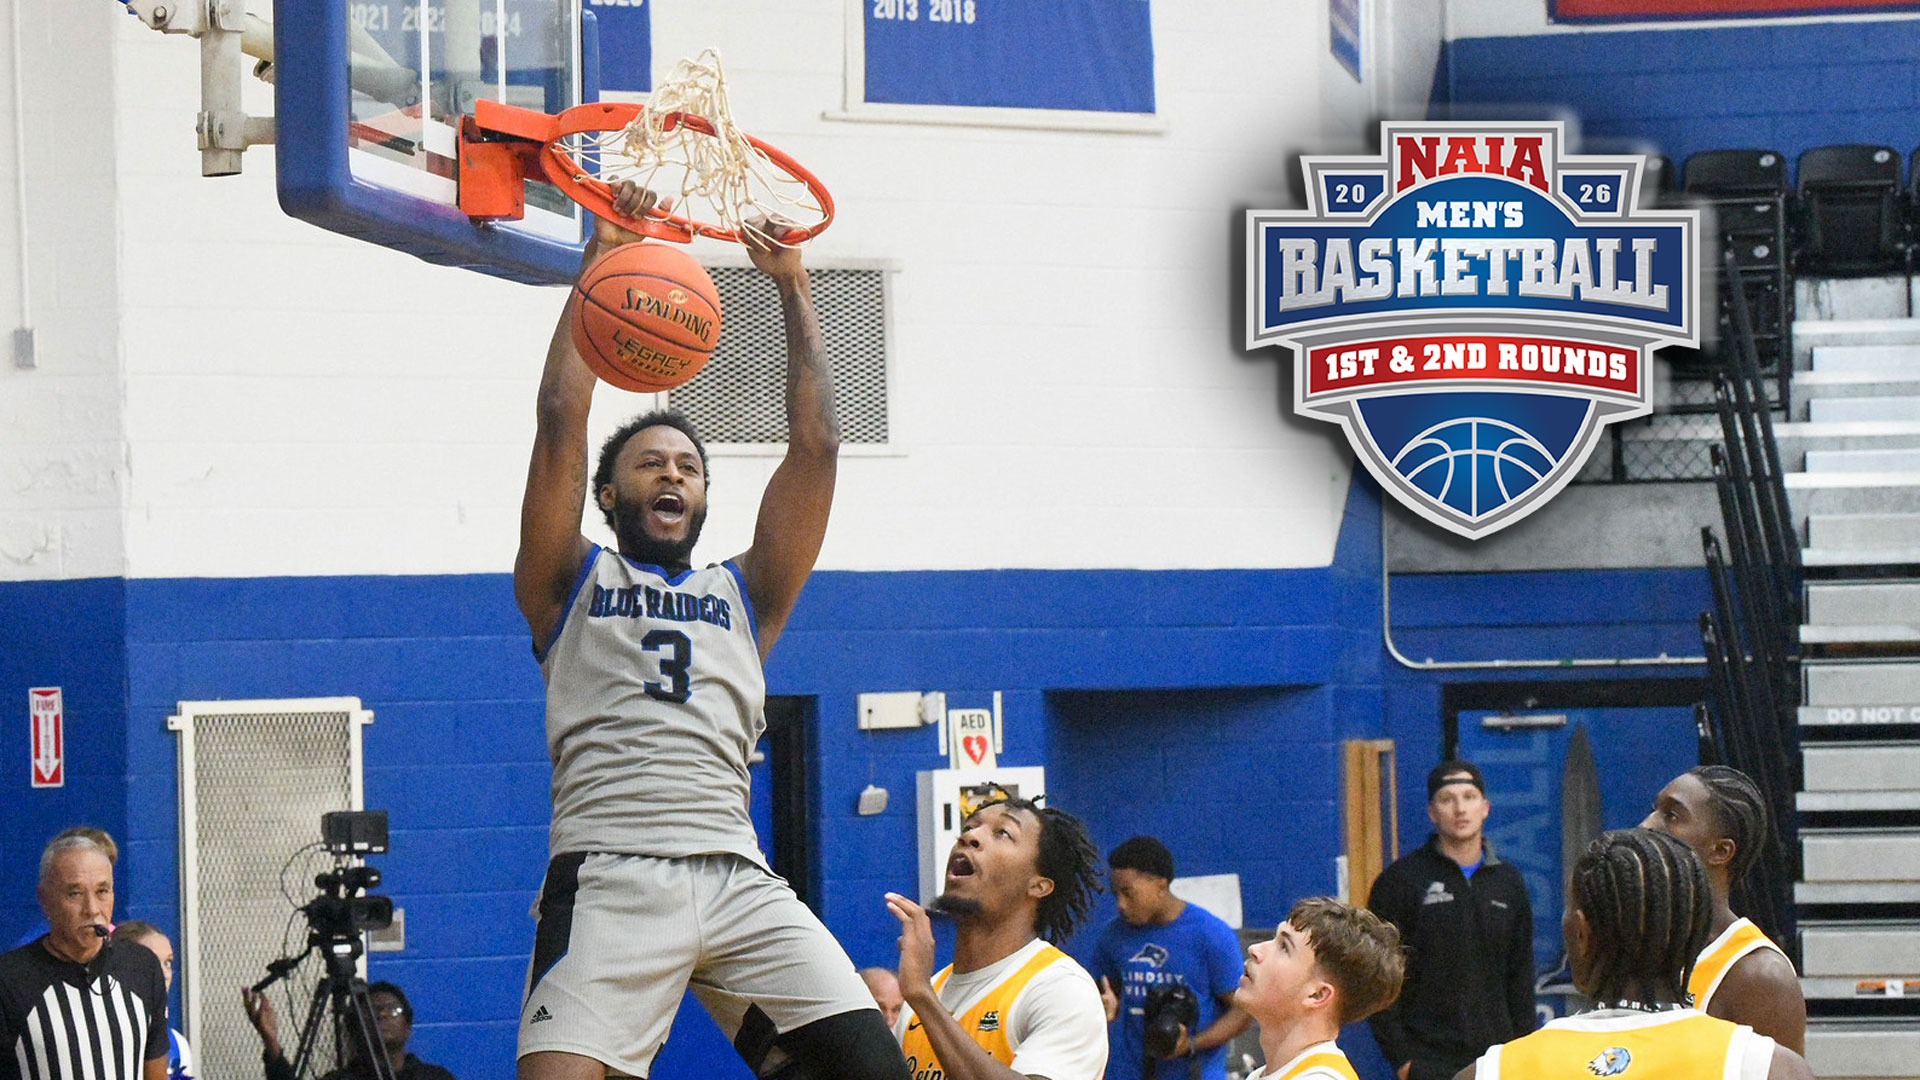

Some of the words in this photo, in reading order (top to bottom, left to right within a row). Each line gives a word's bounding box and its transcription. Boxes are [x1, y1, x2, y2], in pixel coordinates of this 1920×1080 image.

[873, 0, 918, 21] 2013
[928, 0, 976, 24] 2018
[621, 287, 713, 344] SPALDING
[612, 328, 692, 370] LEGACY
[588, 584, 643, 619] BLUE
[645, 585, 731, 632] RAIDERS
[640, 629, 693, 705] 3
[961, 714, 986, 729] AED
[1827, 707, 1856, 725] DO
[1862, 706, 1904, 724] NOT
